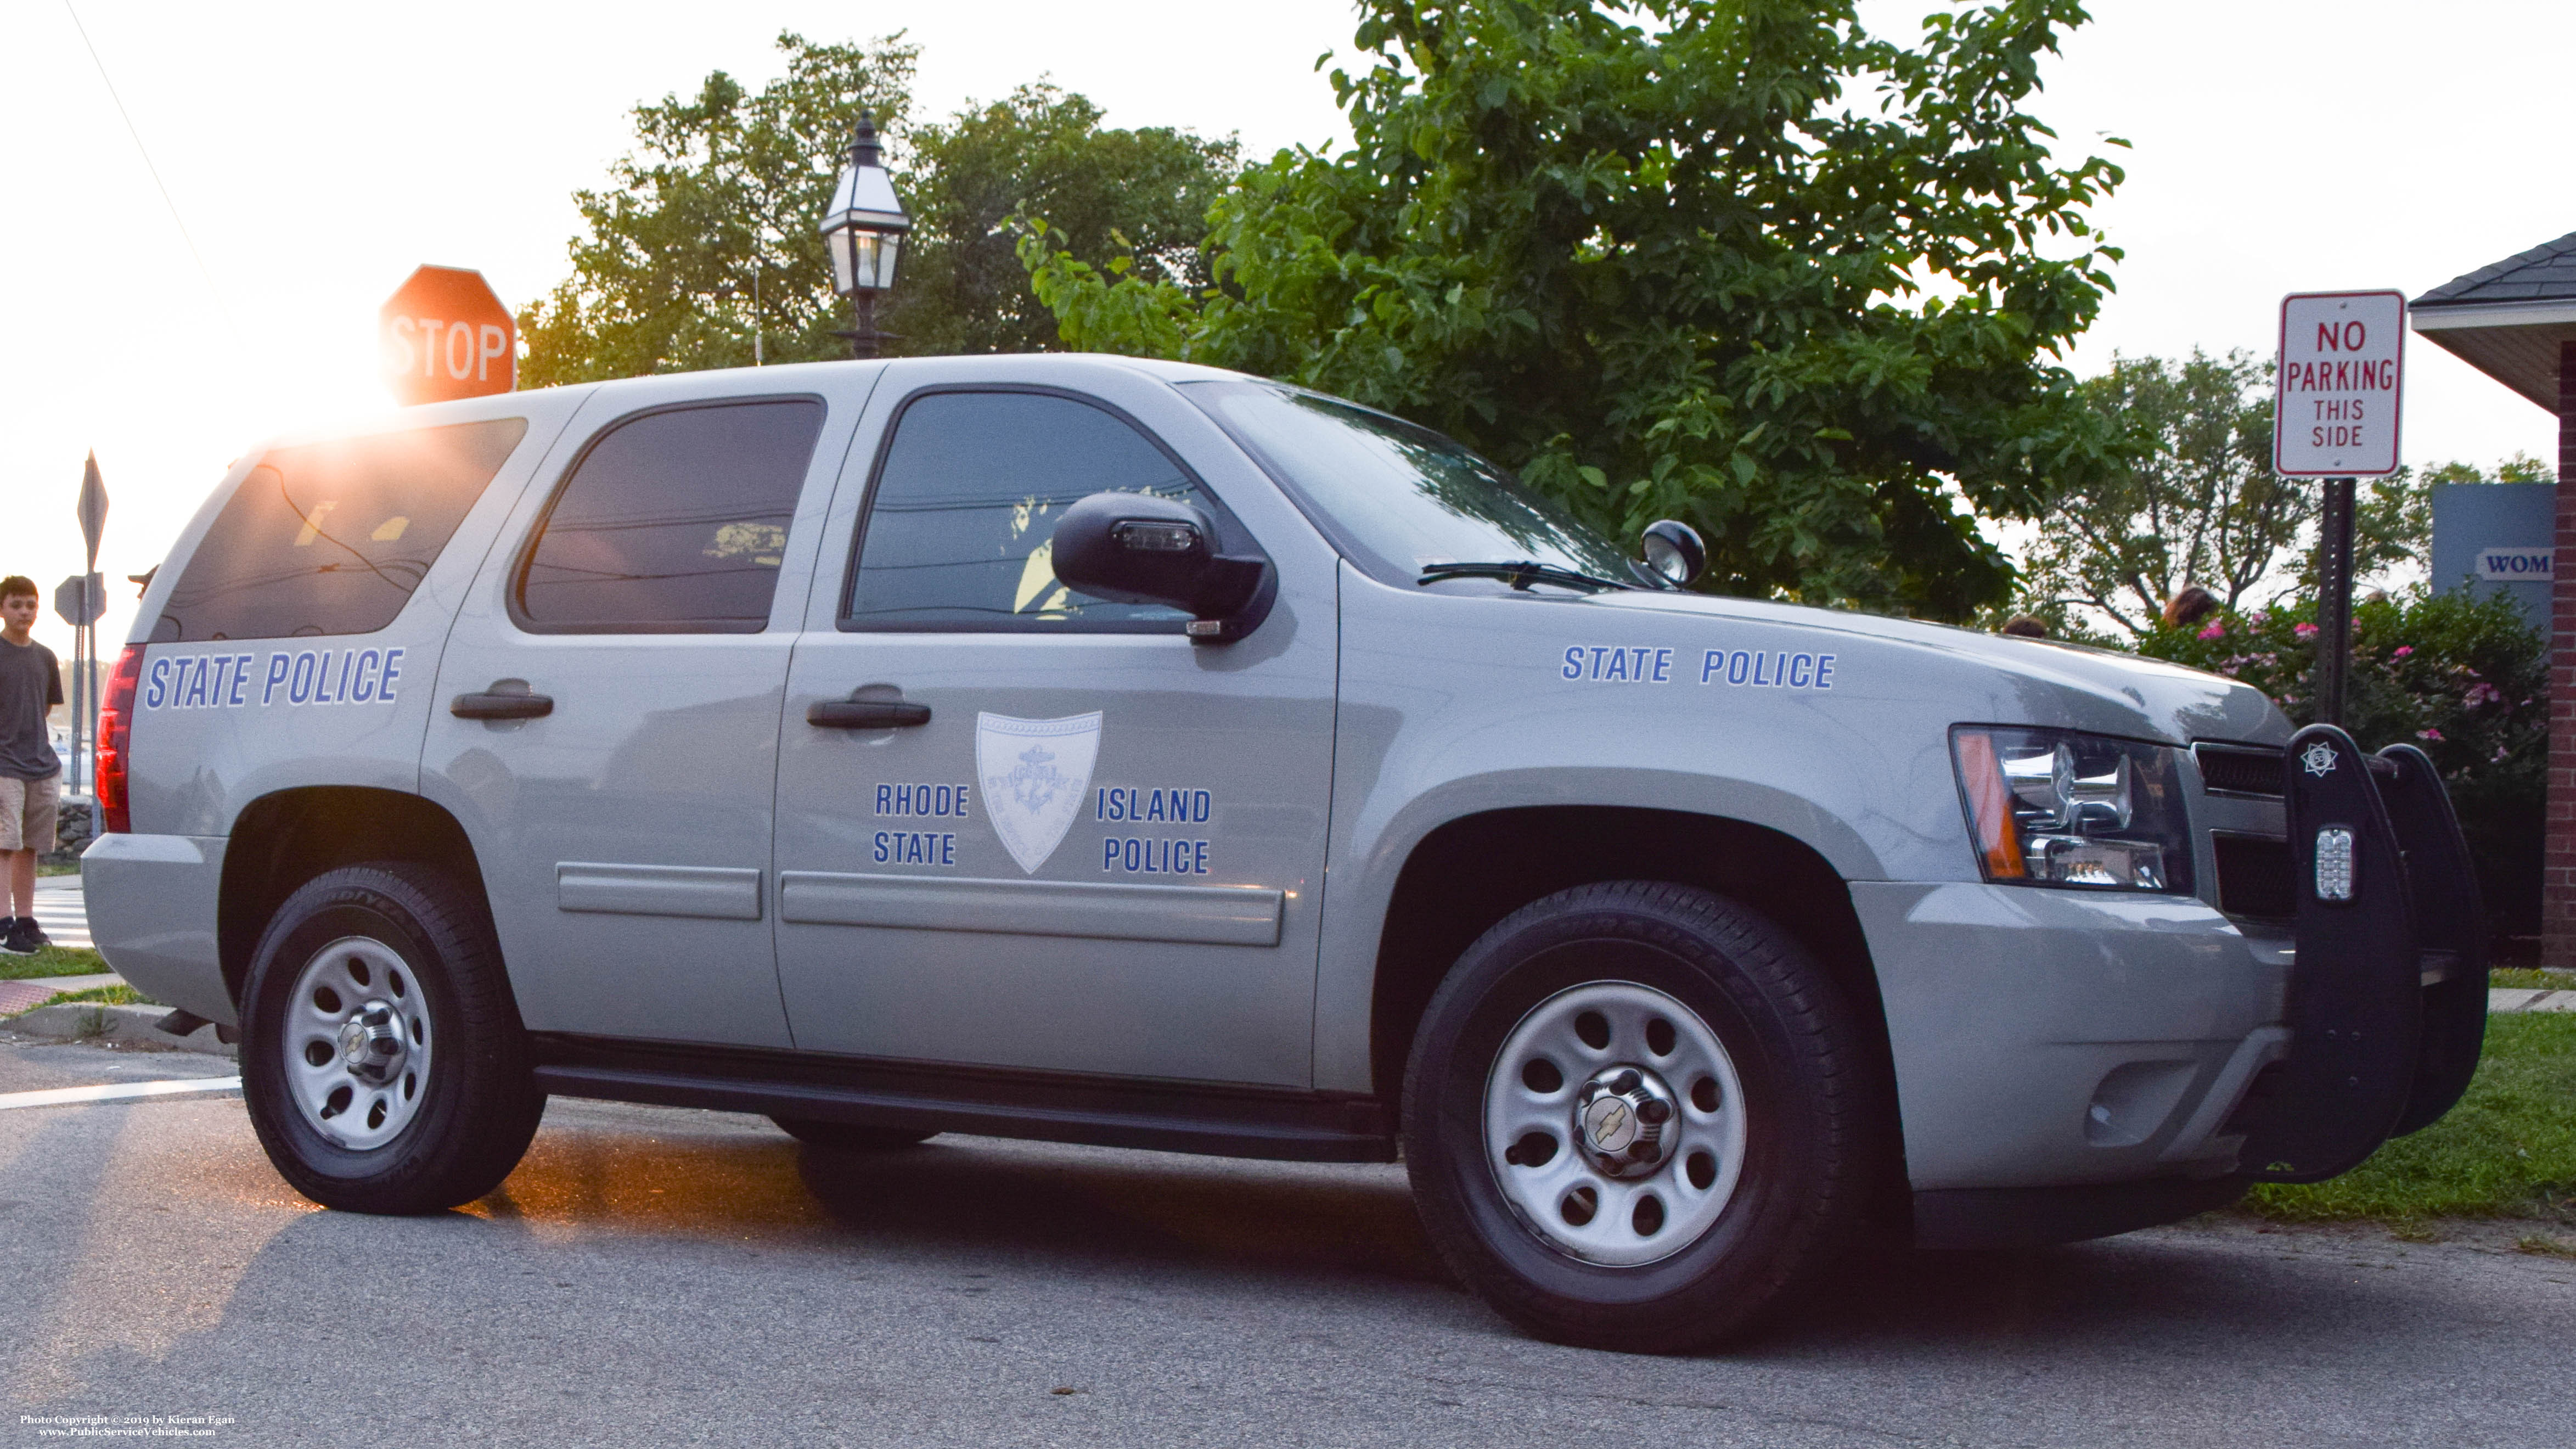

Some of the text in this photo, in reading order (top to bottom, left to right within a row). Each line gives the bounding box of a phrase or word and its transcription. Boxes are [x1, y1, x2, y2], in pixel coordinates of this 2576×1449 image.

[387, 316, 507, 381] STOP
[2318, 321, 2365, 352] NO
[2287, 359, 2393, 392] PARKING
[2314, 399, 2364, 420] THIS
[2312, 426, 2363, 447] SIDE
[2487, 555, 2555, 572] WOM
[147, 648, 405, 710] STATE POLICE
[1562, 645, 1836, 689] STATE POLICE
[875, 784, 1211, 823] RHODE ISLAND
[873, 832, 1209, 874] STATE POLICE
